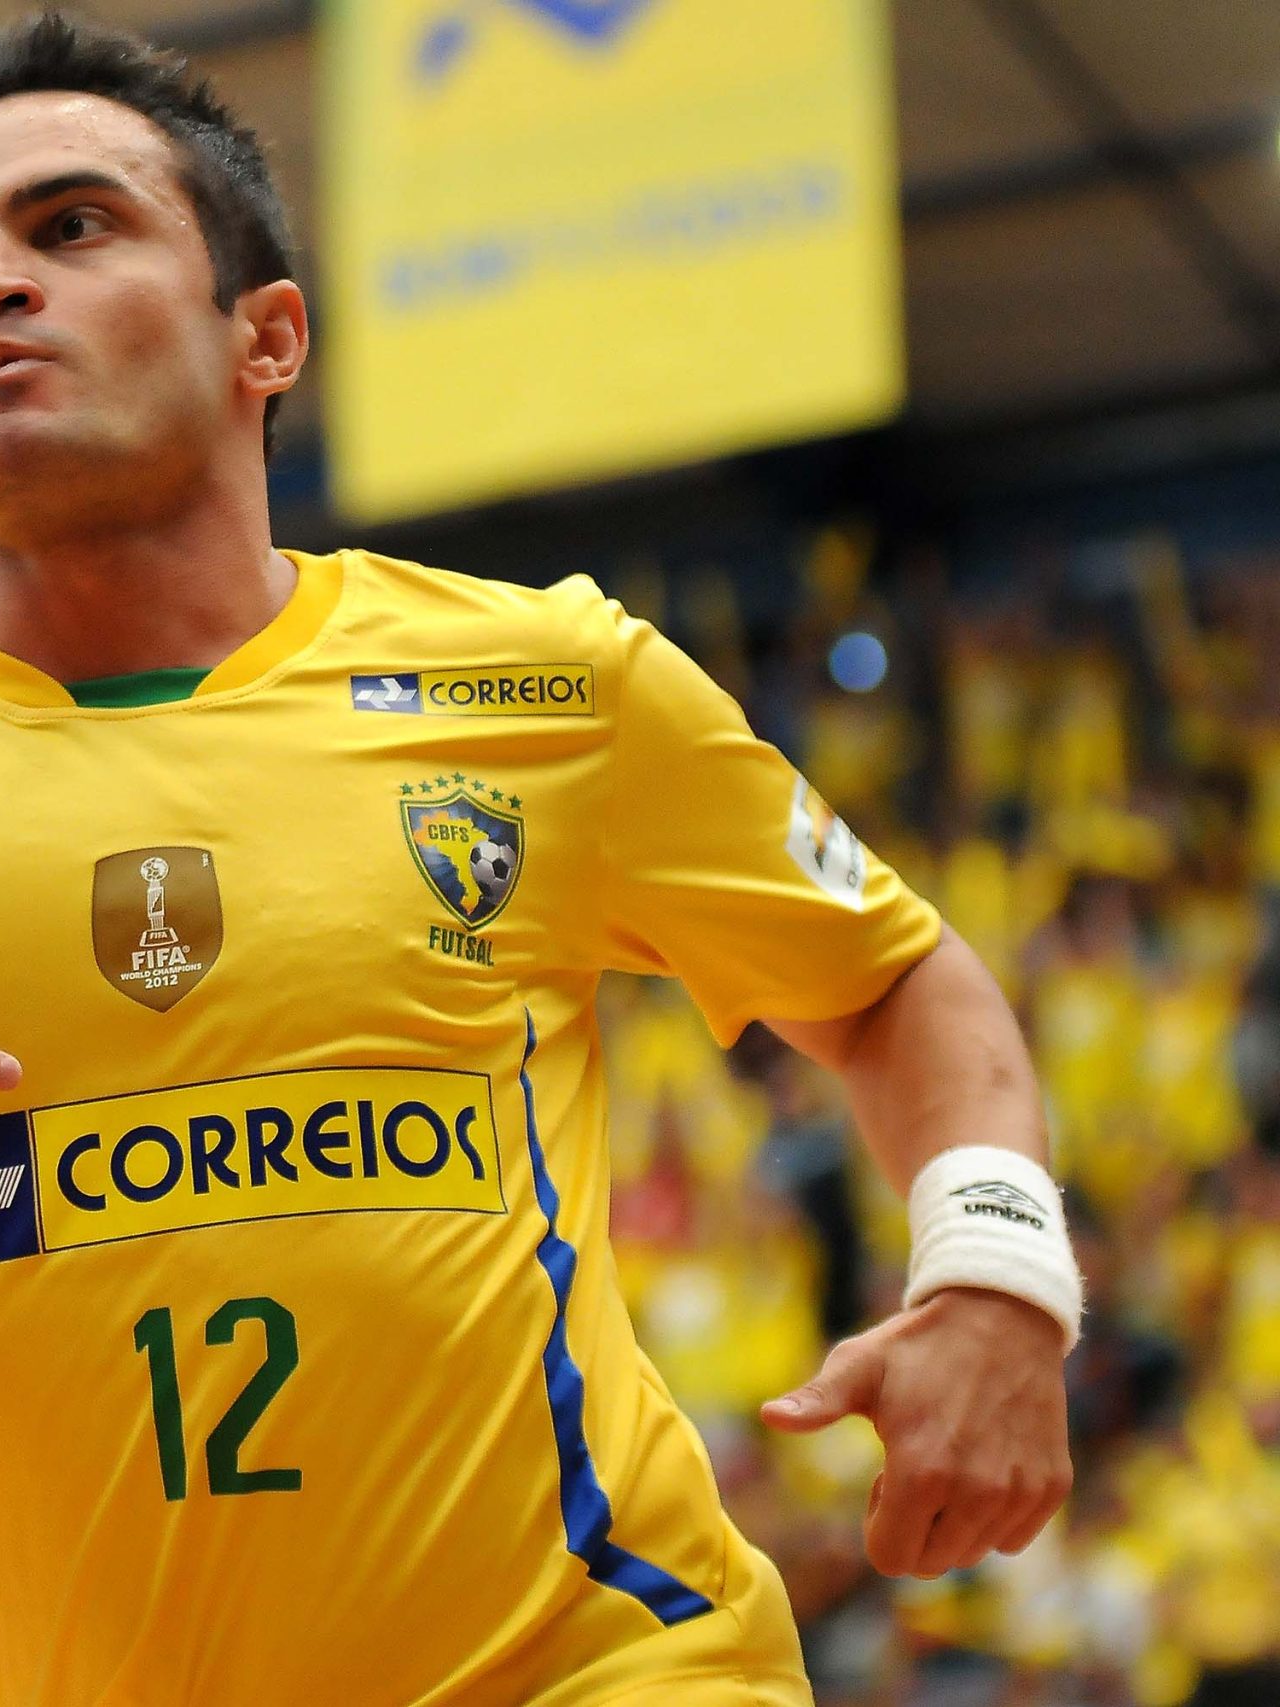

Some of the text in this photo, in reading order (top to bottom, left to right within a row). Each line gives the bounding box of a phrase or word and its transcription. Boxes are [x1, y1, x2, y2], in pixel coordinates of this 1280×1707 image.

[428, 675, 587, 706] CORREIOS
[427, 823, 470, 843] CBFS
[428, 925, 495, 967] FUTSAL
[120, 962, 202, 981] WORLD CHAMPIONS
[145, 974, 179, 989] 2012
[56, 1100, 486, 1212] CORREIOS
[964, 1202, 1044, 1230] umbro
[133, 1296, 302, 1502] 12
